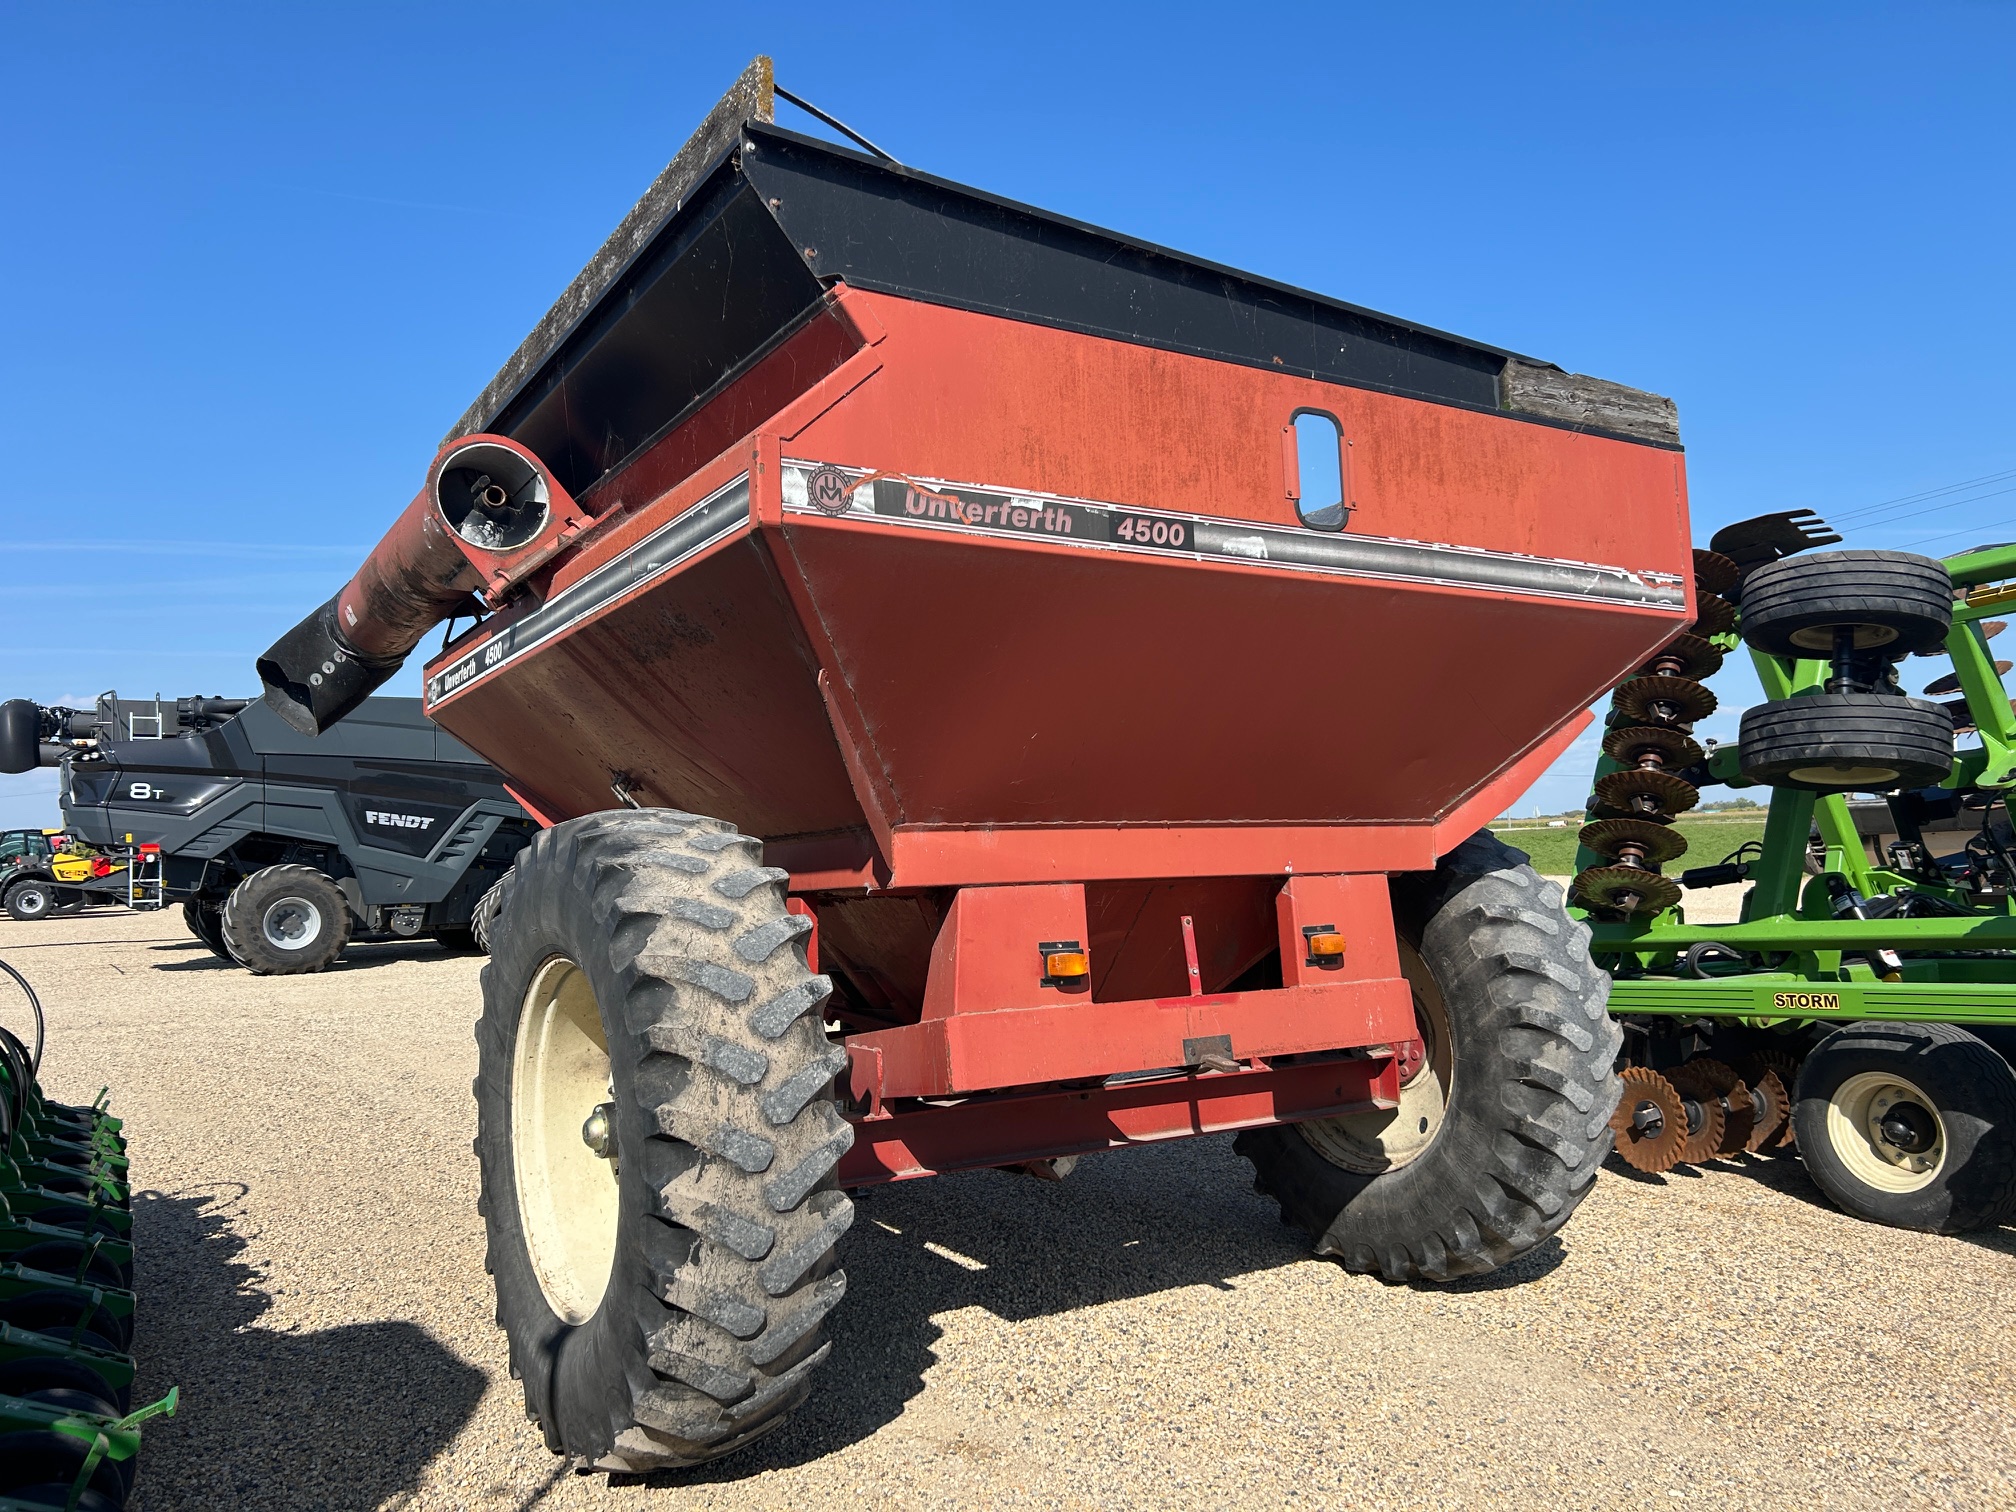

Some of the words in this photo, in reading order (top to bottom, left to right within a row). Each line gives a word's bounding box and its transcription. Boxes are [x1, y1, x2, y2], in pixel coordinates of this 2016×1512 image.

[905, 488, 1073, 534] Unverferth
[1117, 517, 1185, 547] 4500
[444, 658, 476, 692] Unverferth
[485, 641, 503, 666] 4500
[365, 810, 435, 830] FENDT
[1774, 992, 1840, 1010] STORM
